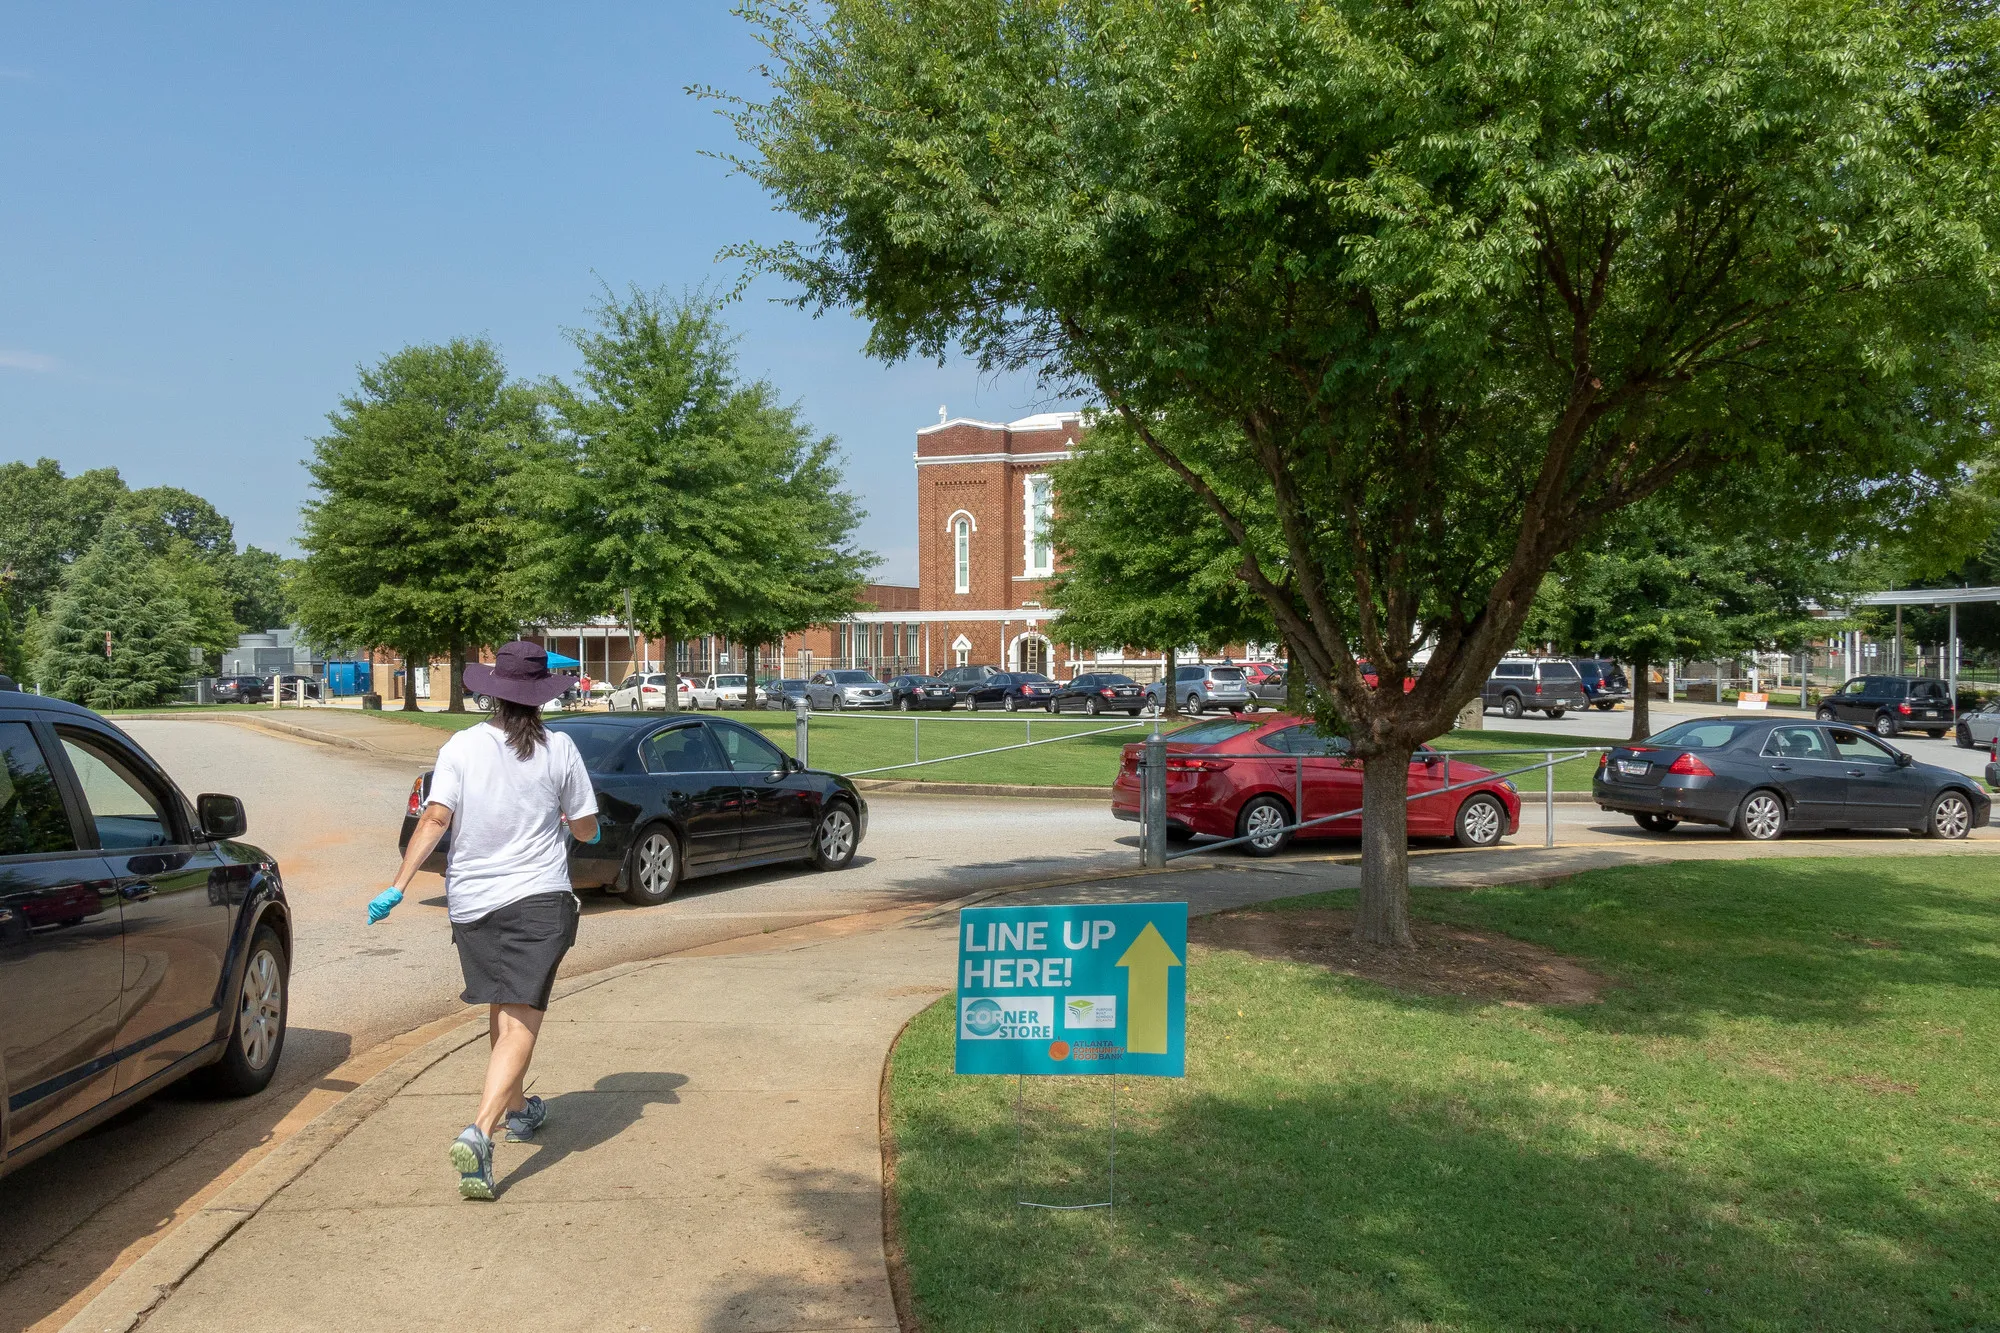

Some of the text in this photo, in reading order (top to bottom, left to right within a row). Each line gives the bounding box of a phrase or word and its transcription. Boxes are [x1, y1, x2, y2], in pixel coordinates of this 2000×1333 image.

[965, 920, 1116, 952] LINE UP
[964, 958, 1073, 988] HERE!
[965, 1010, 1039, 1025] CORNER
[999, 1026, 1051, 1039] STORE
[1073, 1040, 1114, 1048] ATLANTA
